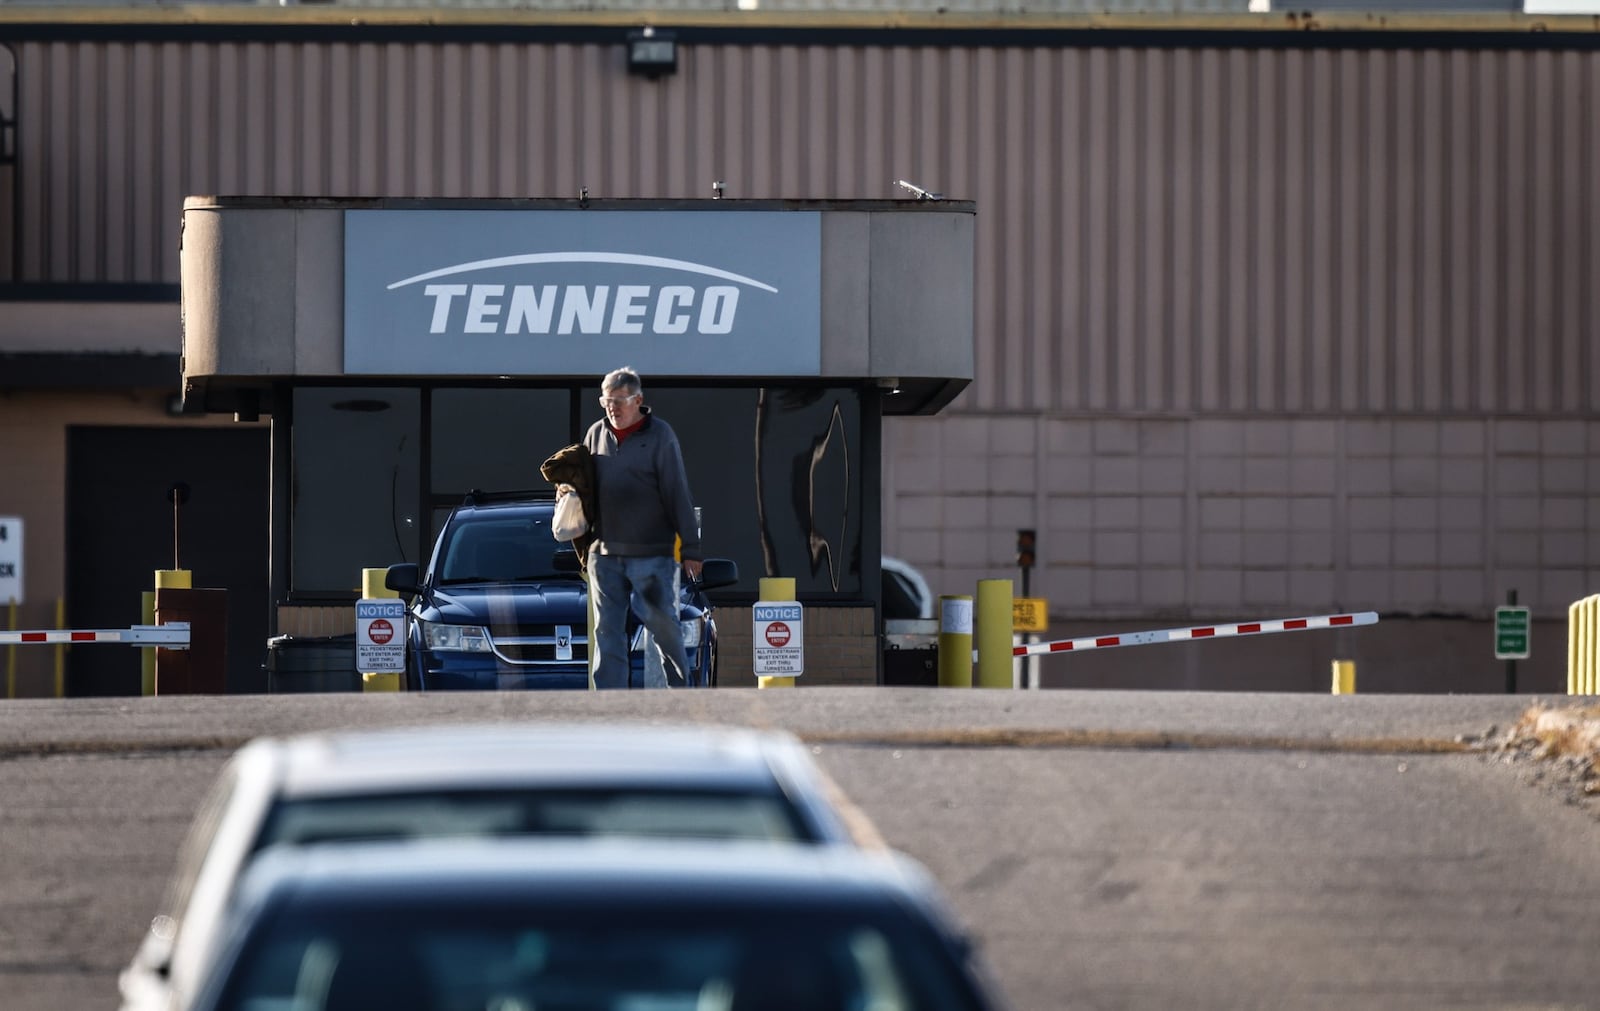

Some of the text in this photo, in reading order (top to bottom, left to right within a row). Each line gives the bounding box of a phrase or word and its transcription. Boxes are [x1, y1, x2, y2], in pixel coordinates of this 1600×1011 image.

[424, 284, 740, 335] TENNECO
[360, 606, 402, 616] NOTICE
[757, 608, 799, 619] NOTICE
